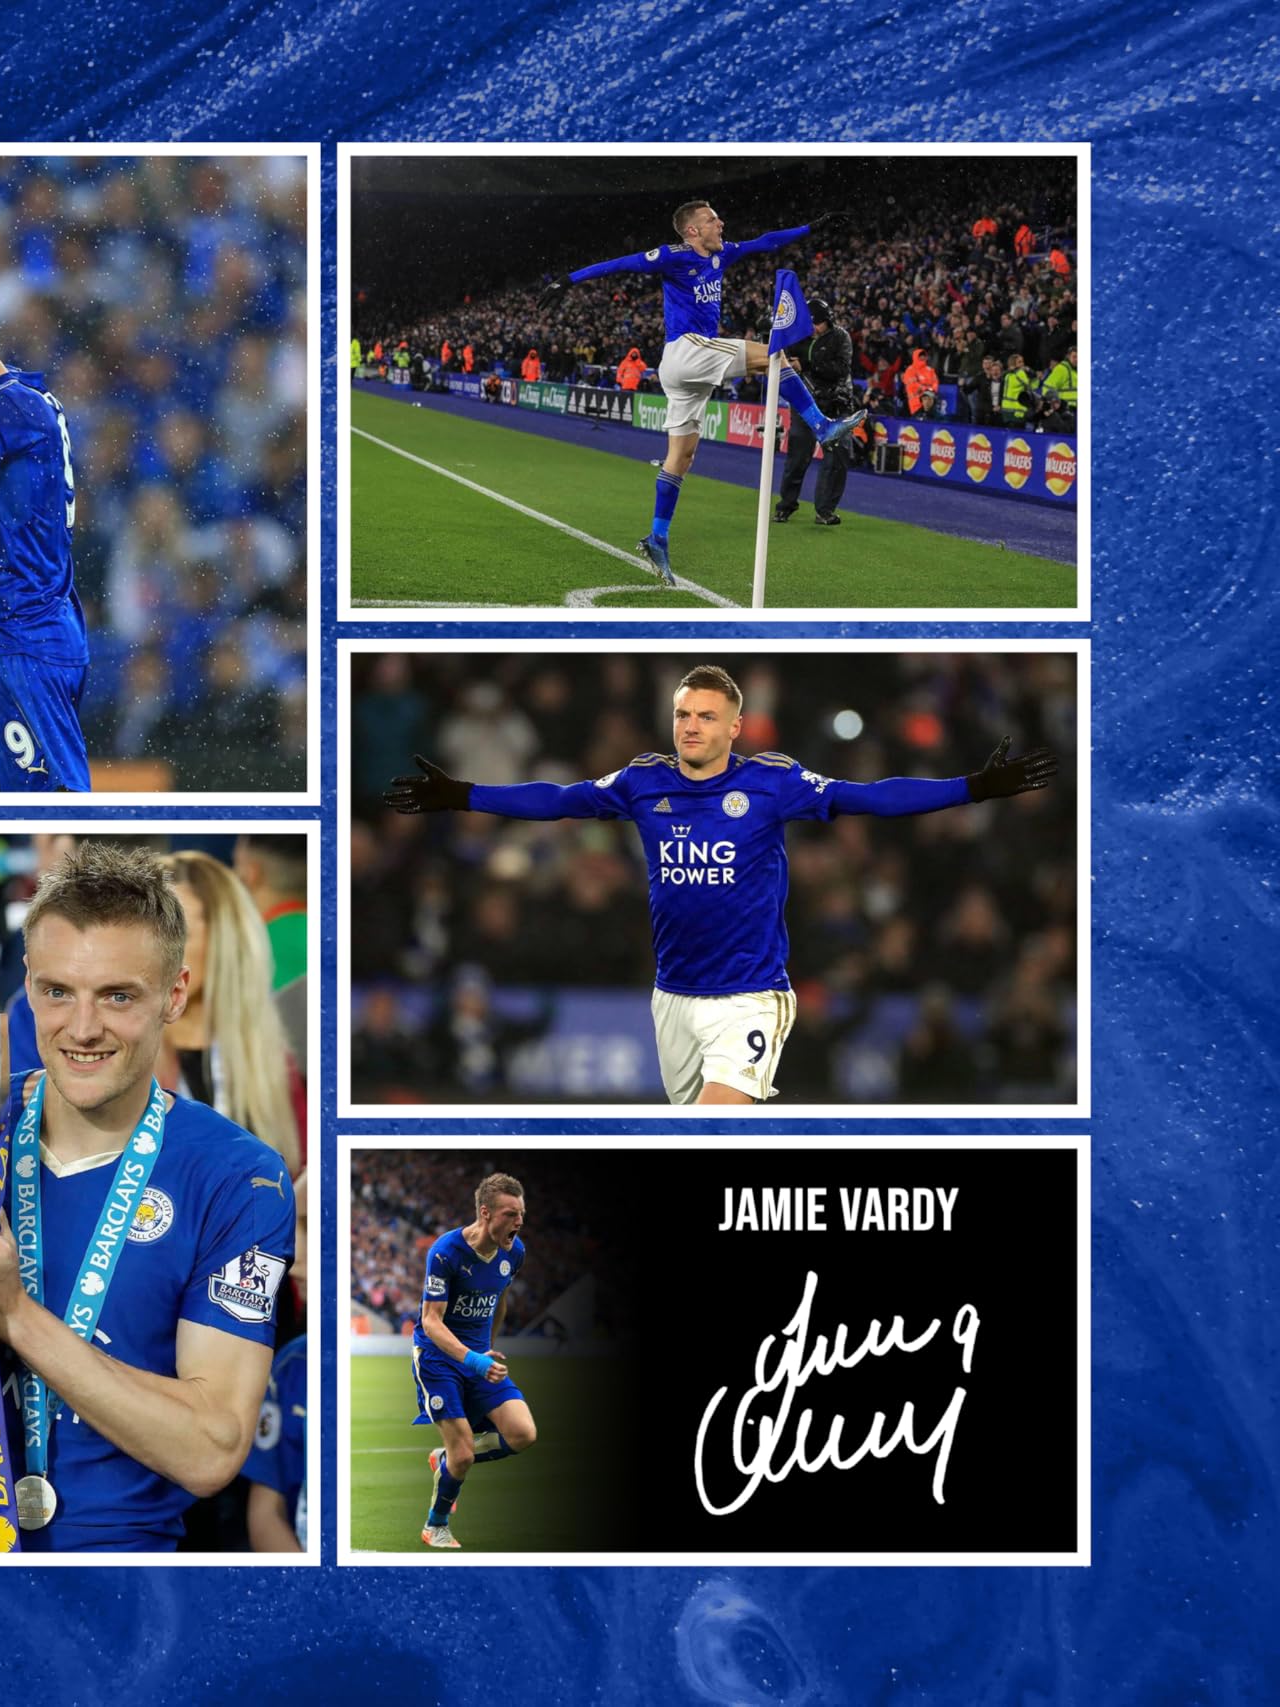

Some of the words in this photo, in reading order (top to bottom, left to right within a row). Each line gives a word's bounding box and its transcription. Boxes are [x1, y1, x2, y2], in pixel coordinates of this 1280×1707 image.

[693, 280, 721, 296] KING
[930, 442, 956, 460] WALKERS
[966, 447, 992, 465] WALKERS
[1004, 452, 1033, 470] WALKERS
[1045, 457, 1077, 476] WALKERS
[3, 720, 36, 769] 9
[659, 840, 737, 864] KING
[660, 867, 737, 885] POWER
[746, 1029, 767, 1065] 9
[89, 1160, 145, 1271] BARCLAYS
[17, 1183, 39, 1296] BARCLAYS
[219, 1284, 266, 1306] BARCLAYS
[455, 1294, 498, 1308] KING
[452, 1304, 494, 1318] POWER
